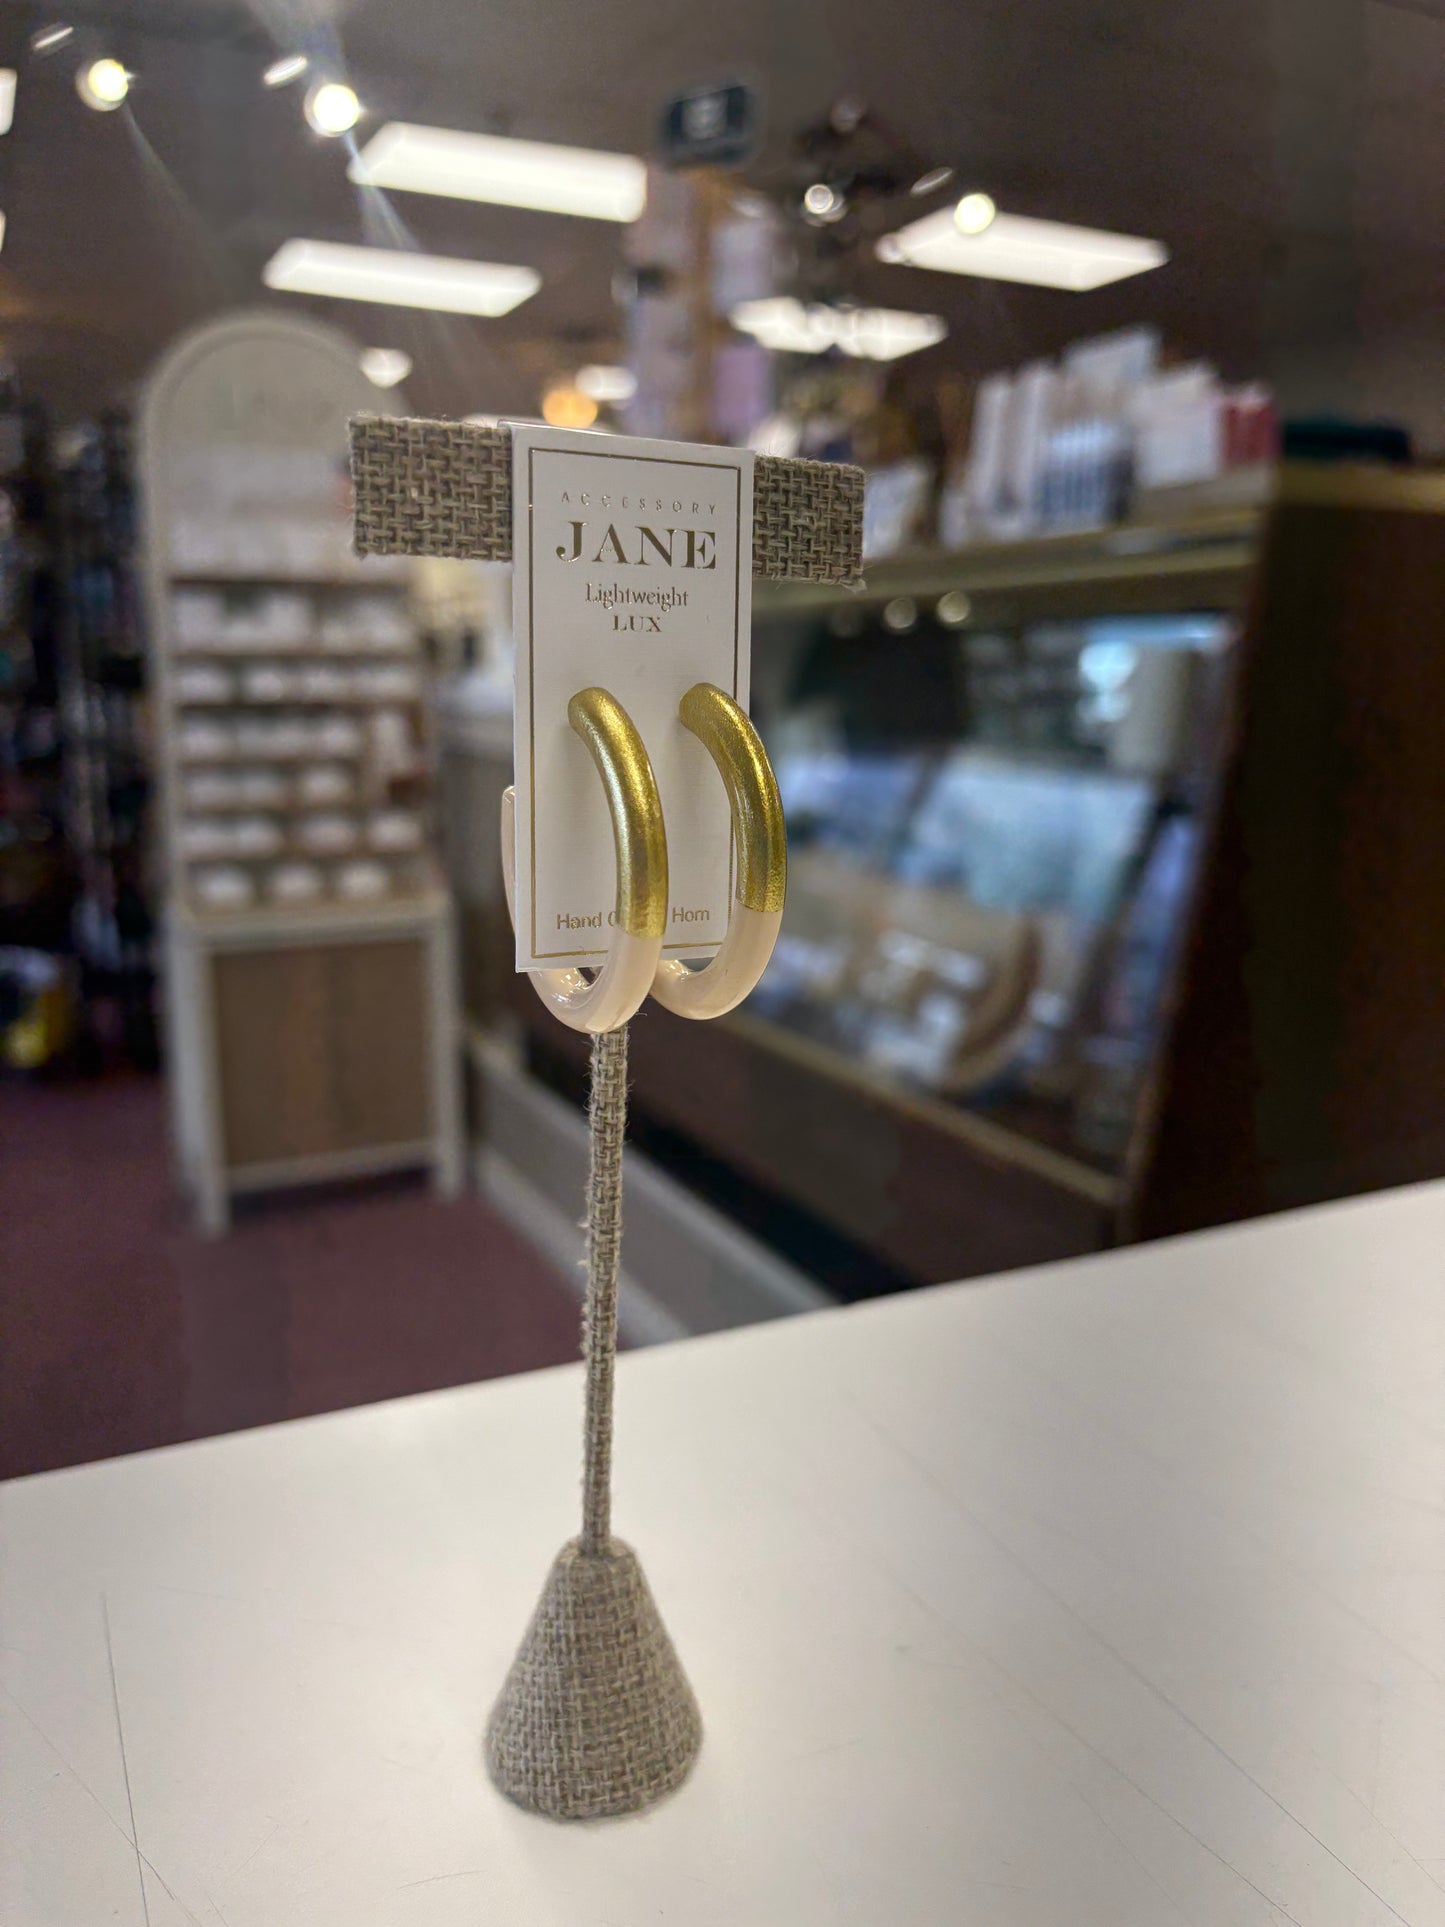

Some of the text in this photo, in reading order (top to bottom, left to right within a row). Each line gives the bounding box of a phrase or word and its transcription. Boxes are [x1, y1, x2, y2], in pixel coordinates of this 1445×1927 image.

[561, 491, 716, 515] ACCESSORY
[555, 521, 717, 570] JANE
[585, 583, 689, 613] Lightweight
[612, 615, 662, 633] LUX
[556, 911, 602, 930] Hand
